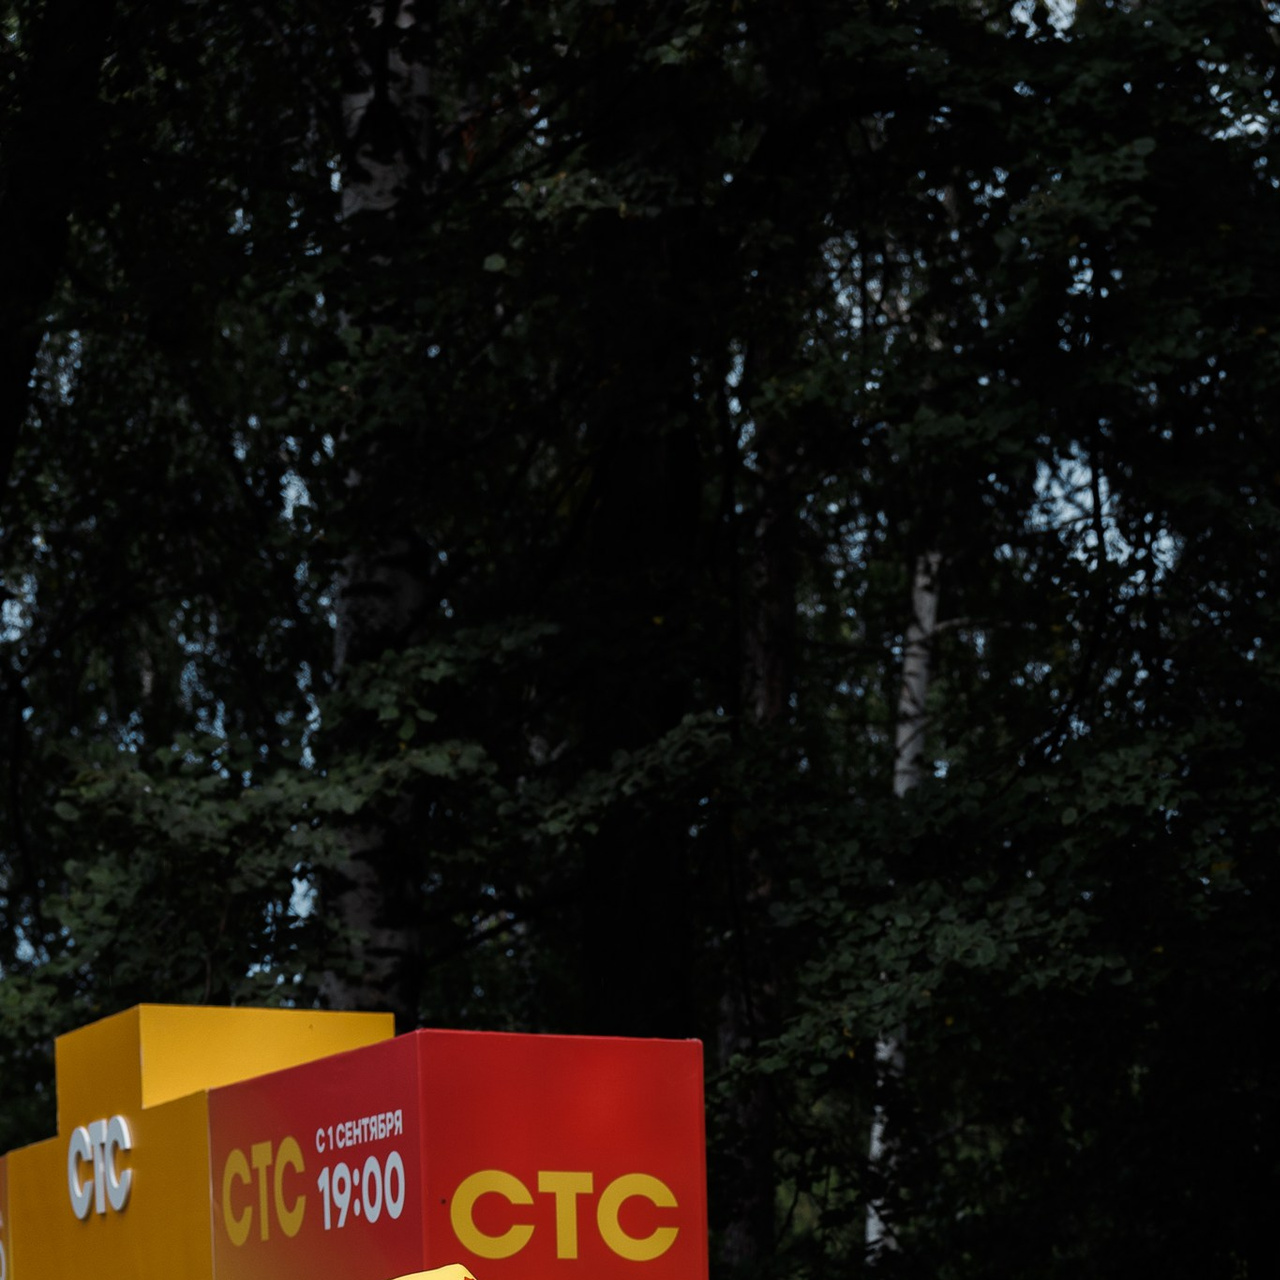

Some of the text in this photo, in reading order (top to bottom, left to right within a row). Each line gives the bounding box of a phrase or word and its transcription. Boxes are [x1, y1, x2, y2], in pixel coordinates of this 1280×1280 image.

[67, 1114, 133, 1219] СТС
[315, 1109, 403, 1153] С 1 СЕНТЯБРЯ
[222, 1135, 306, 1247] СТС
[317, 1150, 406, 1231] 19:00
[450, 1169, 680, 1262] СТС
